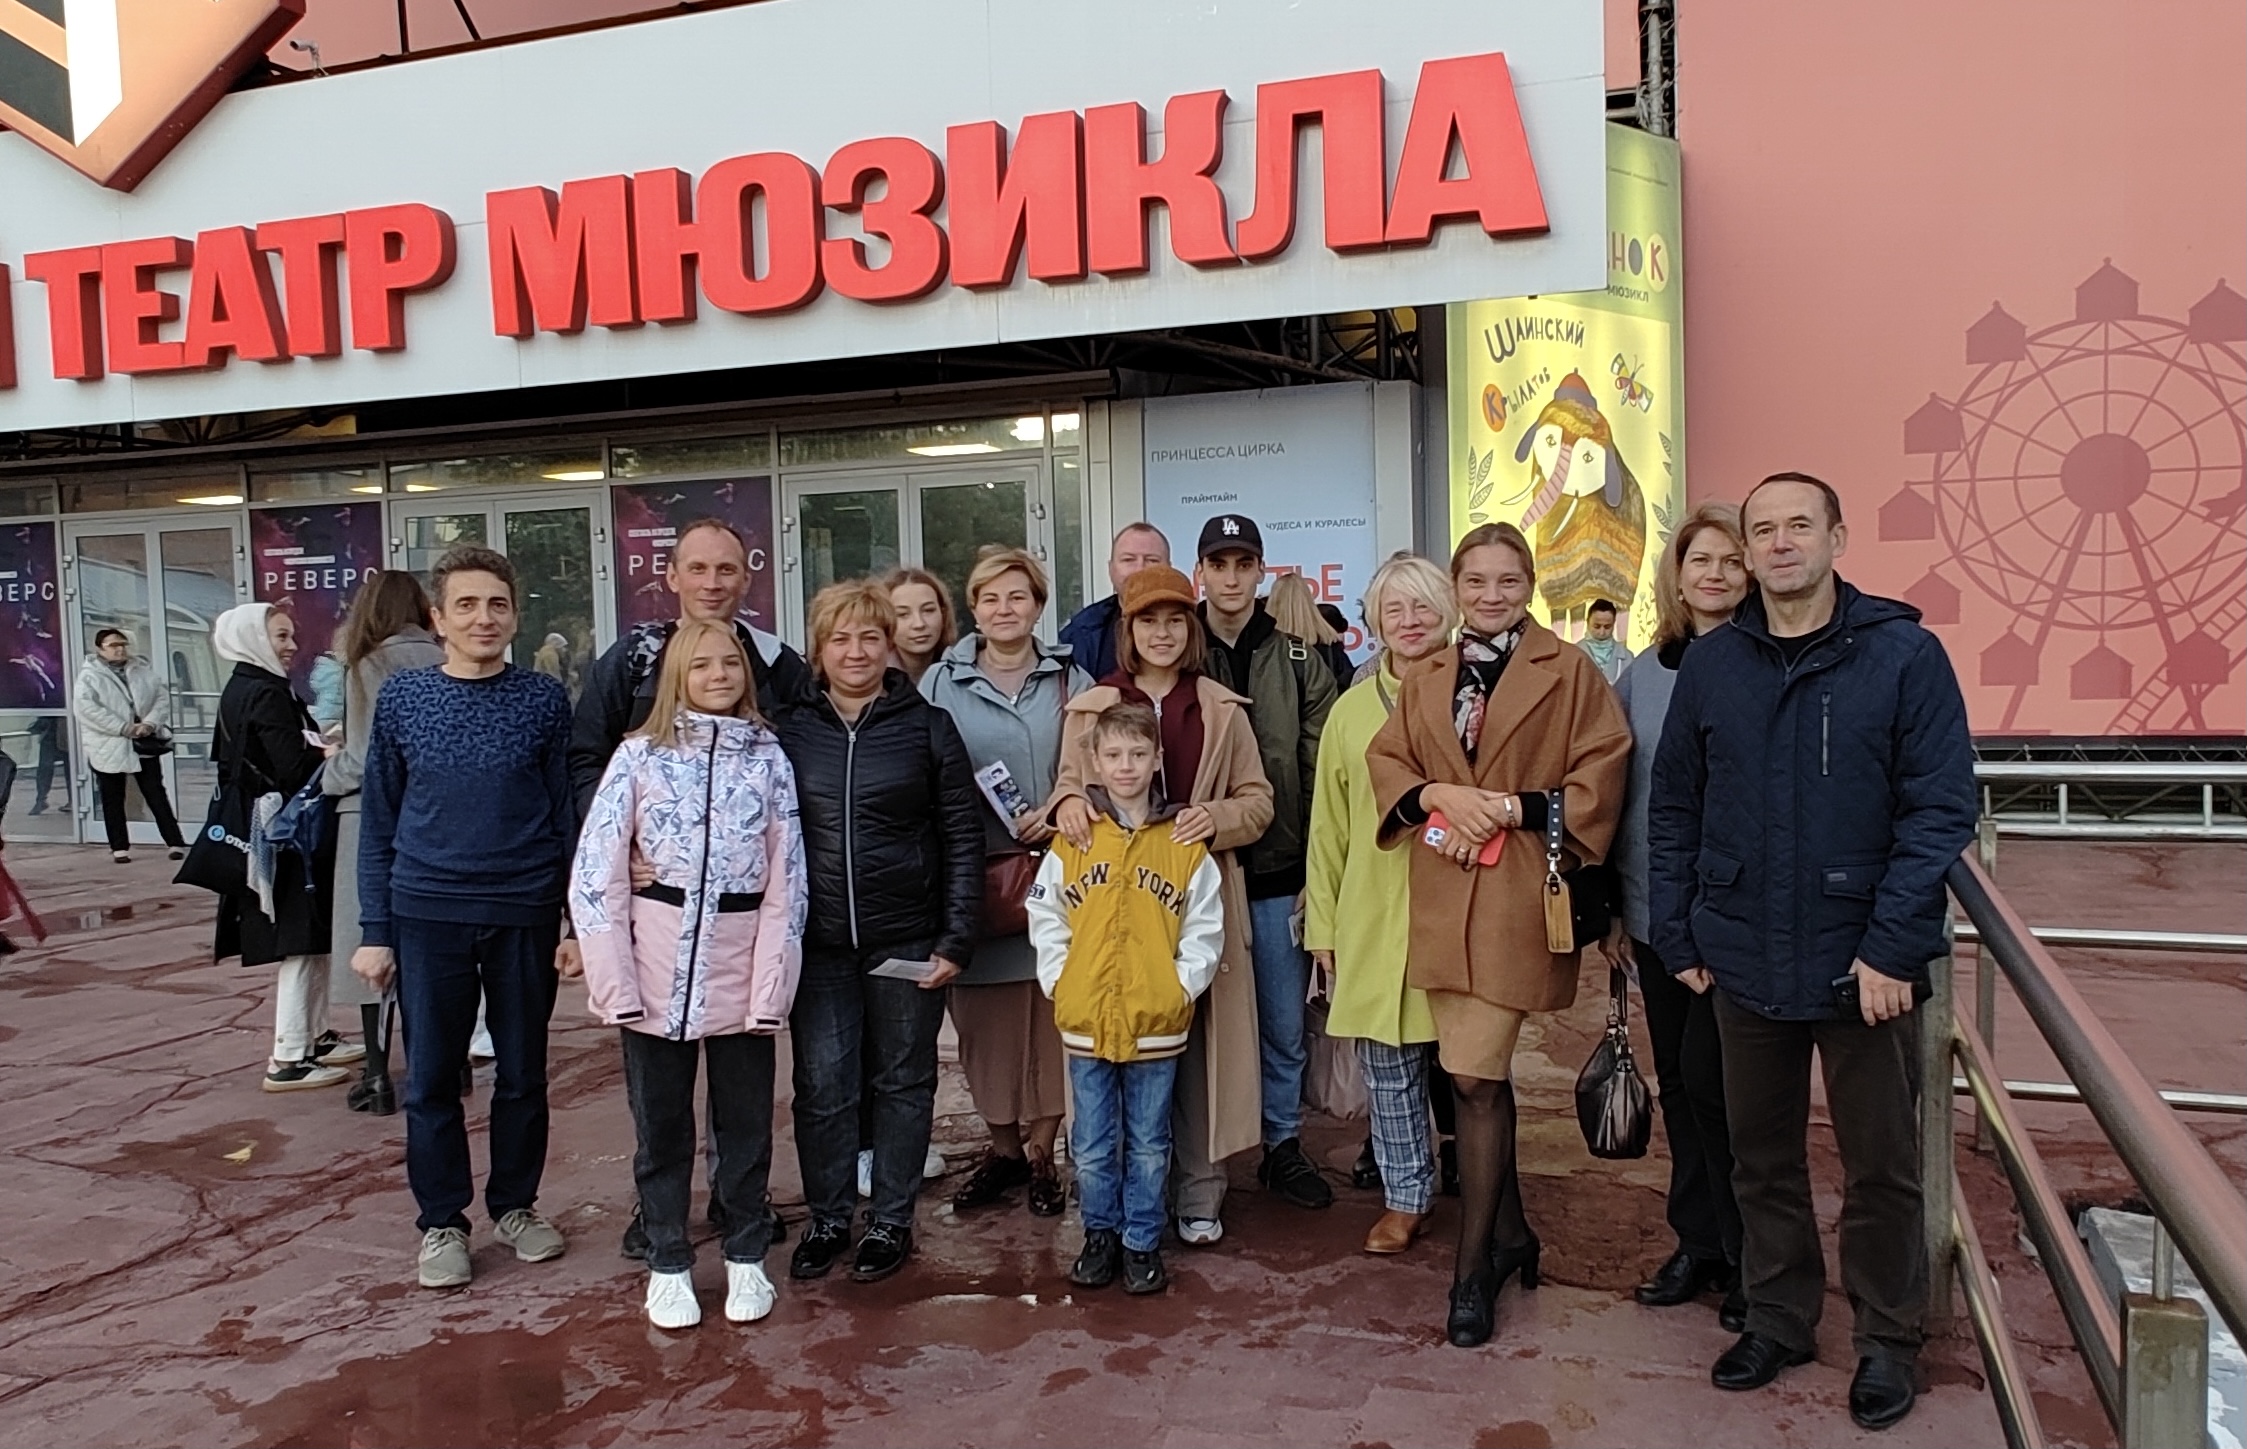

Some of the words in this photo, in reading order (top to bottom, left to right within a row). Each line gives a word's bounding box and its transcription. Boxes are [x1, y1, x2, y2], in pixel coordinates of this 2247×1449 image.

[24, 203, 456, 379] ТЕАТР
[487, 52, 1549, 338] МЮЗИКЛА
[1609, 230, 1664, 282] НОК
[1608, 285, 1649, 302] МЮЗИКЛ
[1484, 315, 1585, 363] ШАИНСКИЙ
[1151, 446, 1235, 463] ПРИНЦЕССА
[1238, 442, 1285, 459] ЦИРКА
[1181, 492, 1238, 504] ПРАЙМТАЙМ
[1265, 521, 1302, 531] ЧУДЕСА
[1305, 520, 1312, 529] И
[1315, 518, 1366, 528] КУРАЛЕСЫ
[0, 582, 55, 602] ЕРС
[1064, 863, 1110, 909] NEW
[1136, 866, 1186, 916] YORK
